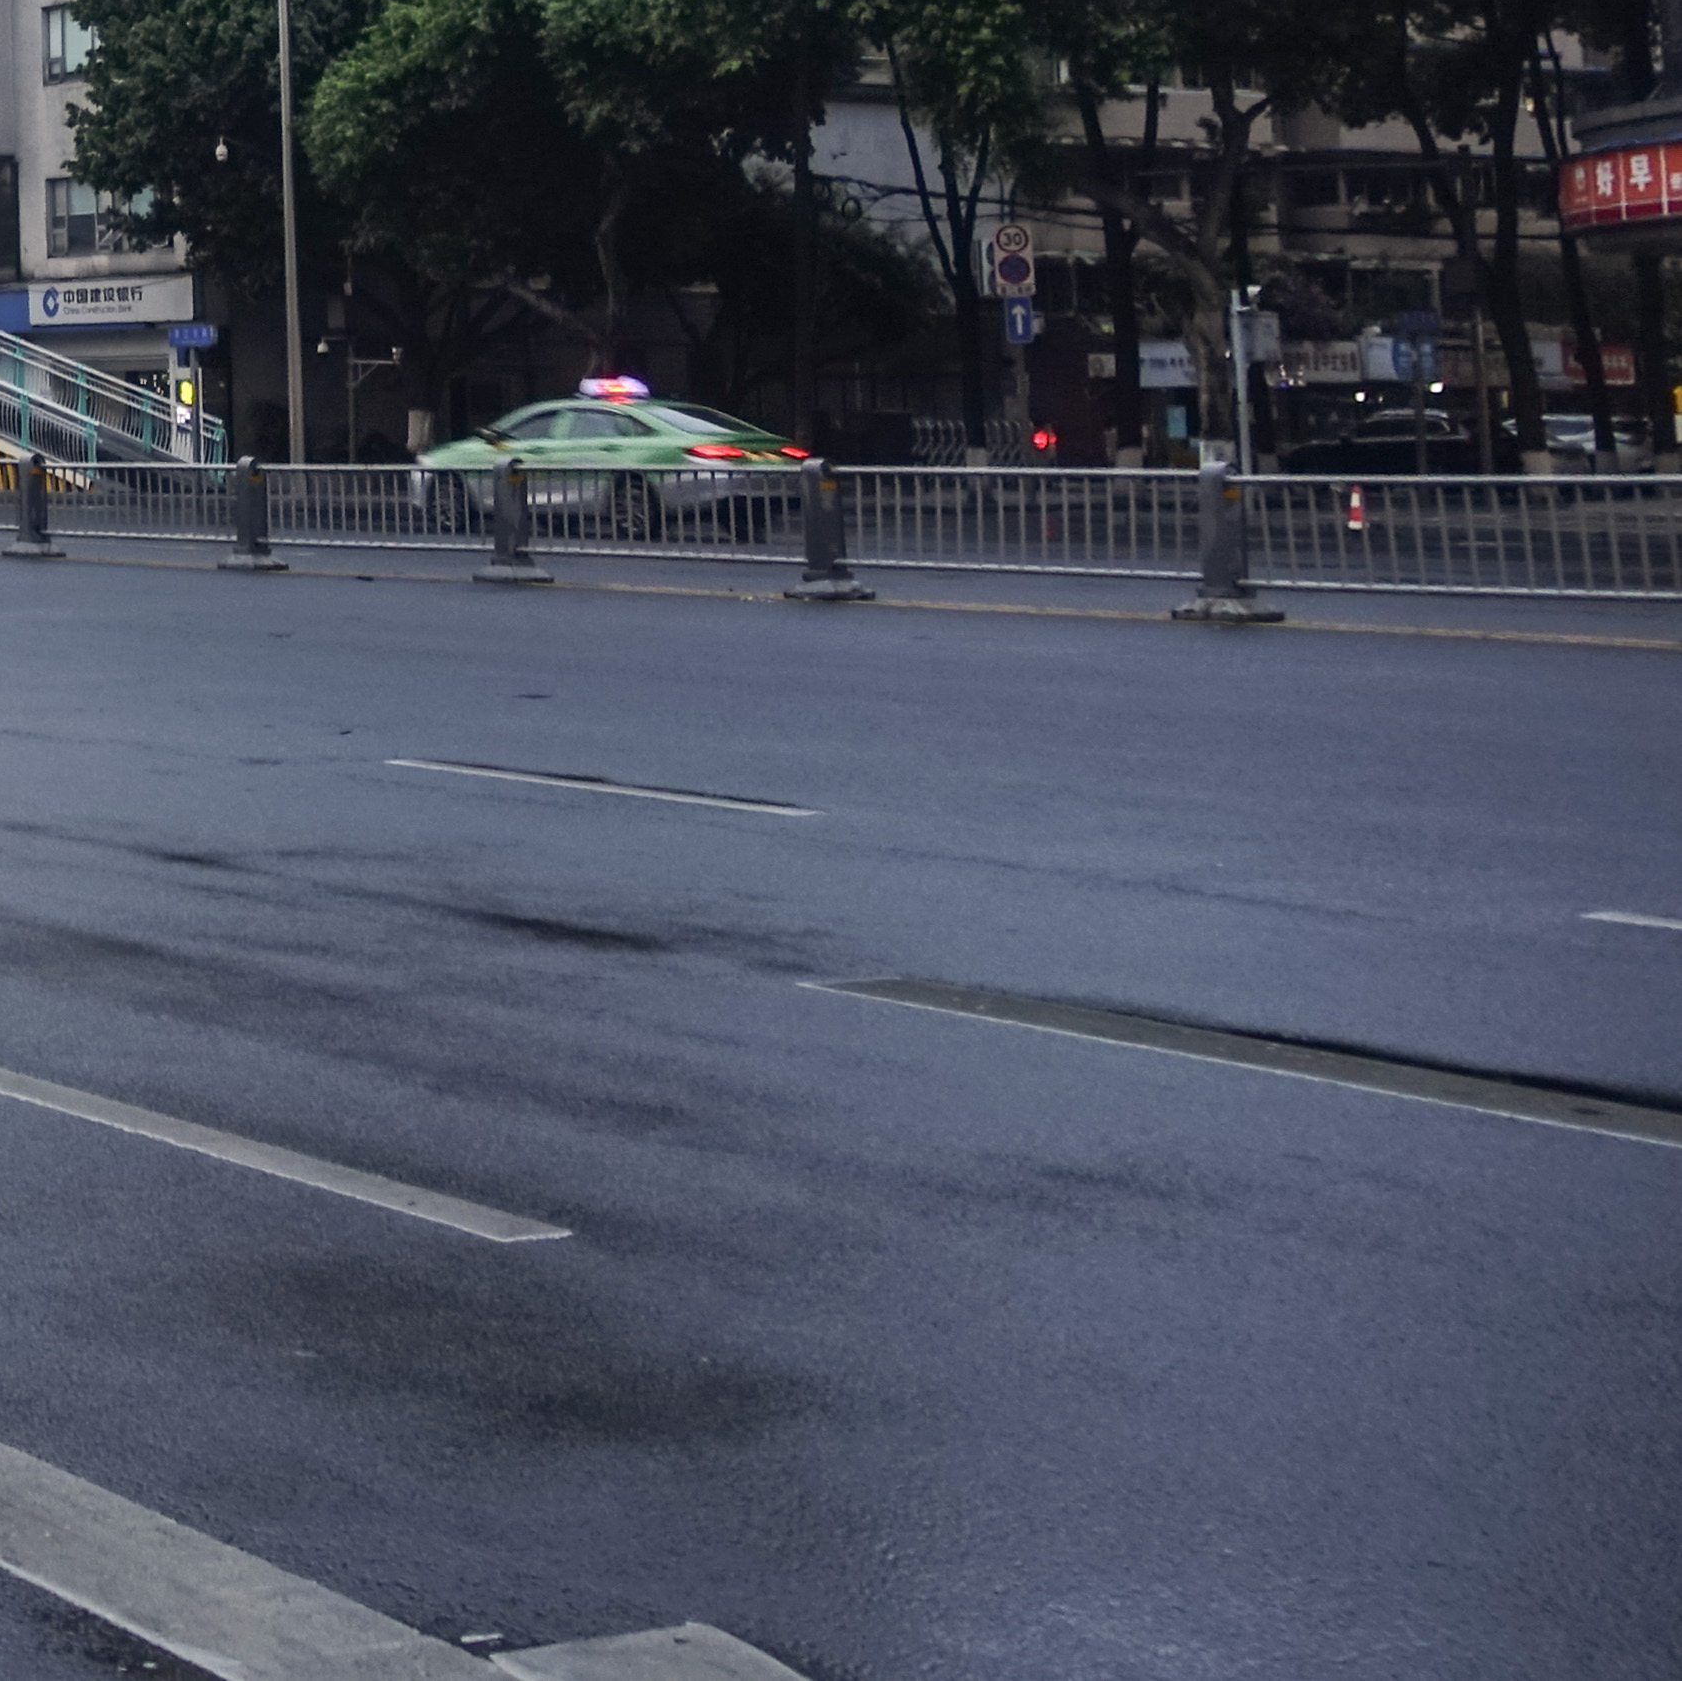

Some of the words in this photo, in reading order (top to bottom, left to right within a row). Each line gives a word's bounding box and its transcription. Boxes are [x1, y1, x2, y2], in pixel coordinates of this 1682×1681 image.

[1003, 233, 1023, 246] 30
[63, 286, 143, 304] 中国建设银行
